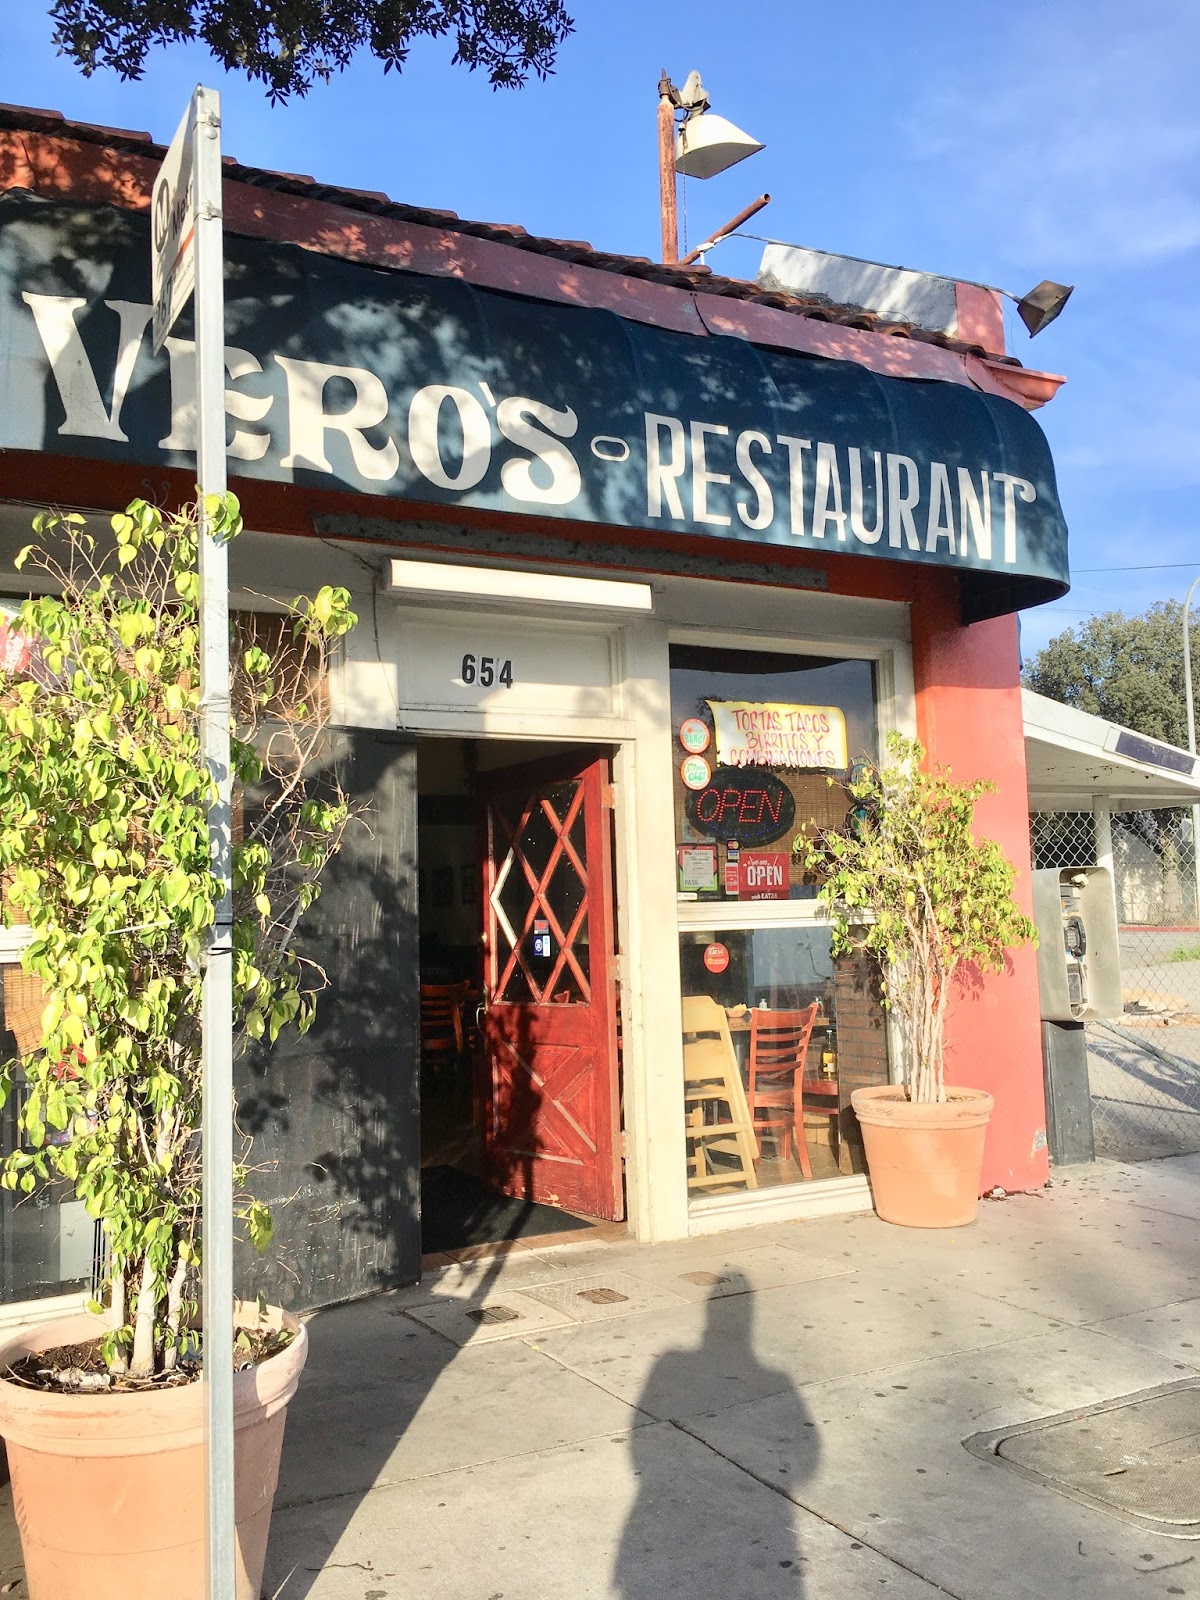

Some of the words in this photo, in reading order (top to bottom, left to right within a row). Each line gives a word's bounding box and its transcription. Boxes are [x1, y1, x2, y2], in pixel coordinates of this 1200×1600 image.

[172, 184, 193, 240] Metr
[22, 291, 581, 506] VERO'S
[644, 411, 1037, 563] RESTAURANT
[462, 653, 514, 689] 654
[732, 708, 782, 731] TORTAS
[785, 711, 830, 733] TACOS
[745, 731, 808, 751] BURRITOS
[812, 734, 824, 751] Y
[696, 789, 784, 823] OPEN
[747, 865, 783, 886] OPEN
